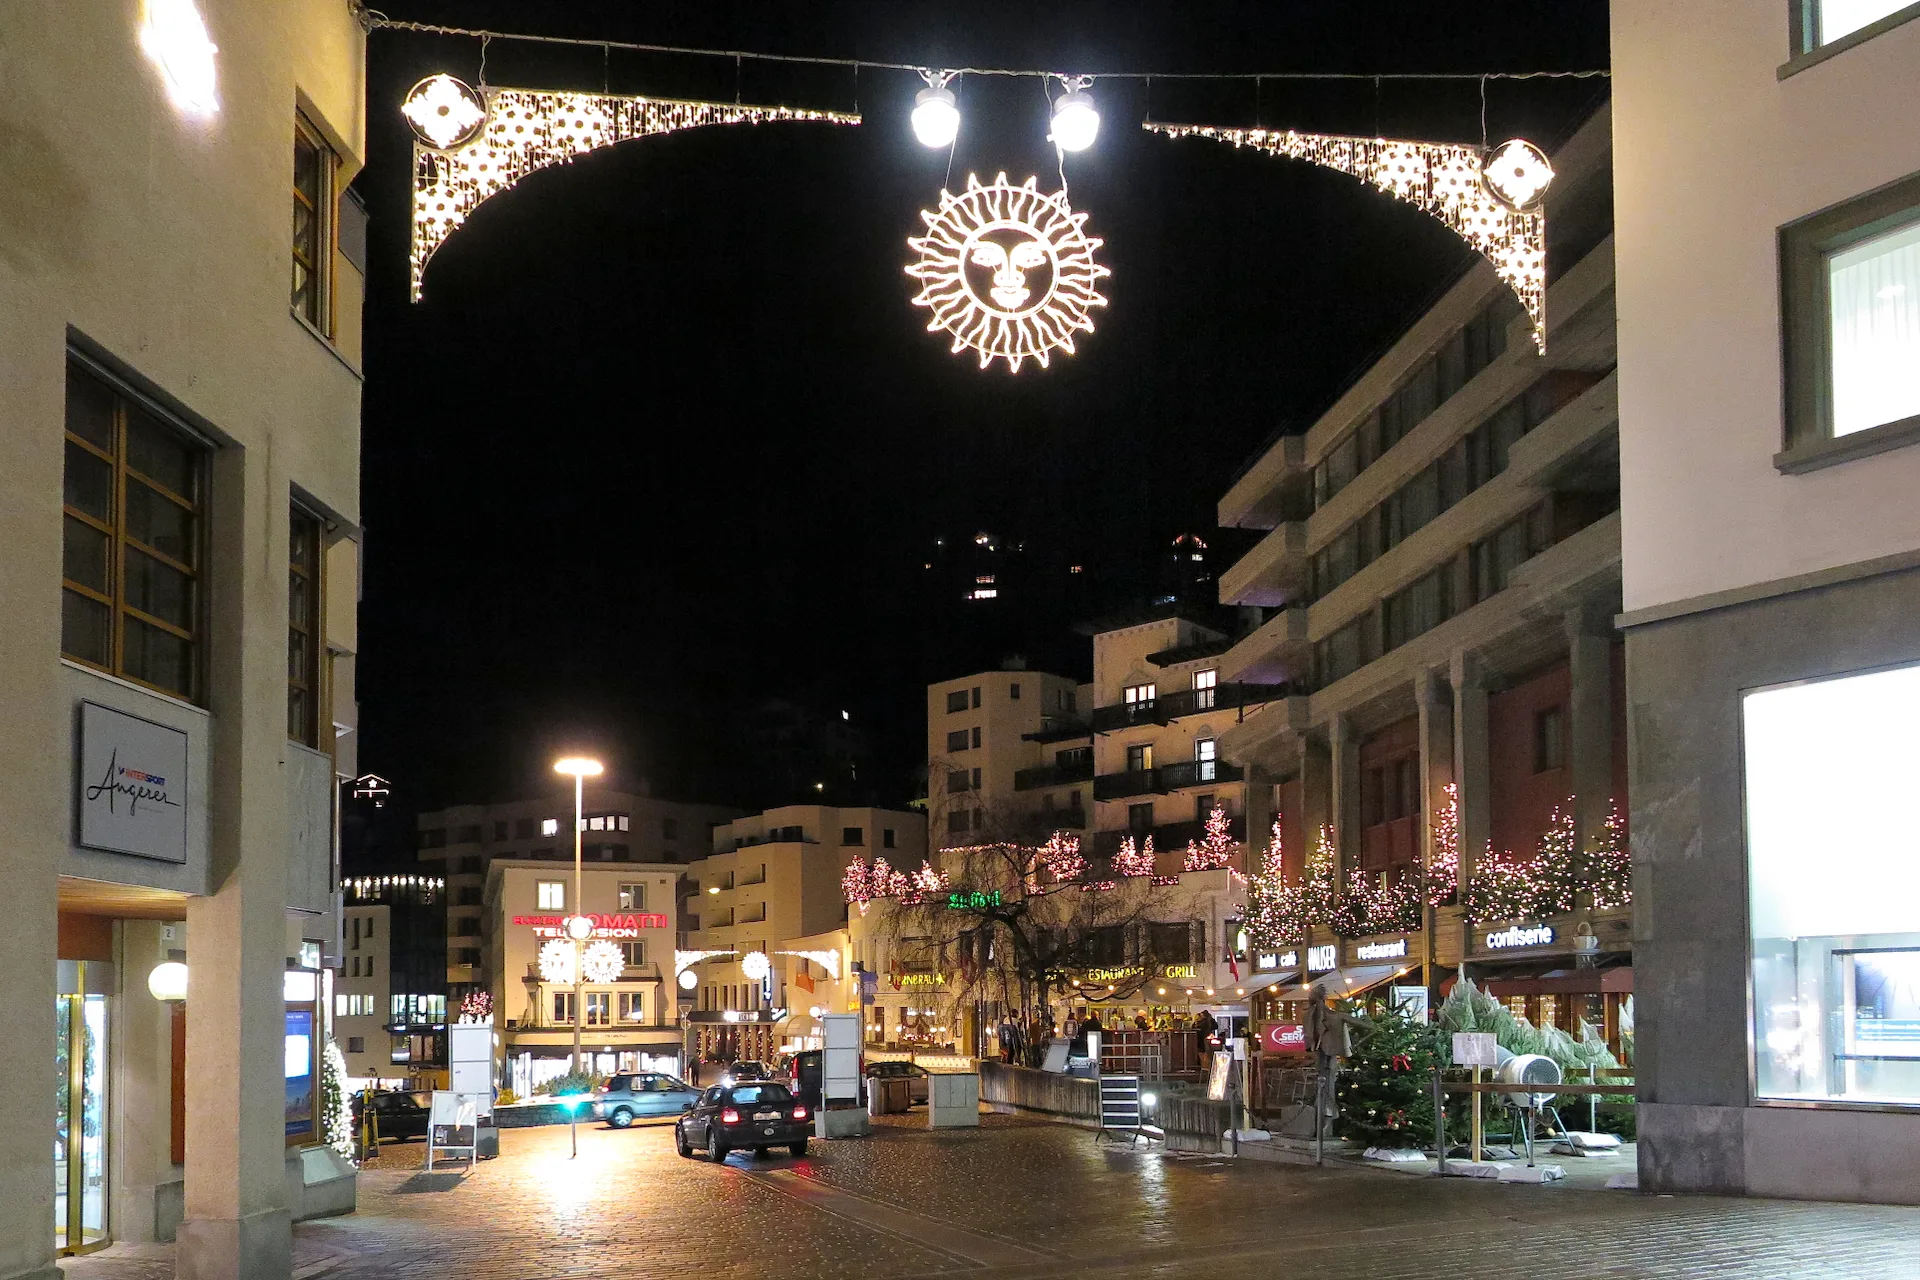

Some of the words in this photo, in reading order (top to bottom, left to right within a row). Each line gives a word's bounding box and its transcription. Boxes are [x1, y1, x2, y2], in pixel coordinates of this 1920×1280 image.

[87, 747, 181, 816] Angerer
[568, 913, 668, 929] OMATTI
[532, 927, 638, 938] TELISION
[1486, 923, 1554, 949] confiserie
[1308, 944, 1336, 971] HAUSER
[1357, 938, 1405, 960] restaurant
[1086, 967, 1145, 981] ESTAURANT
[1166, 965, 1197, 979] GRILL
